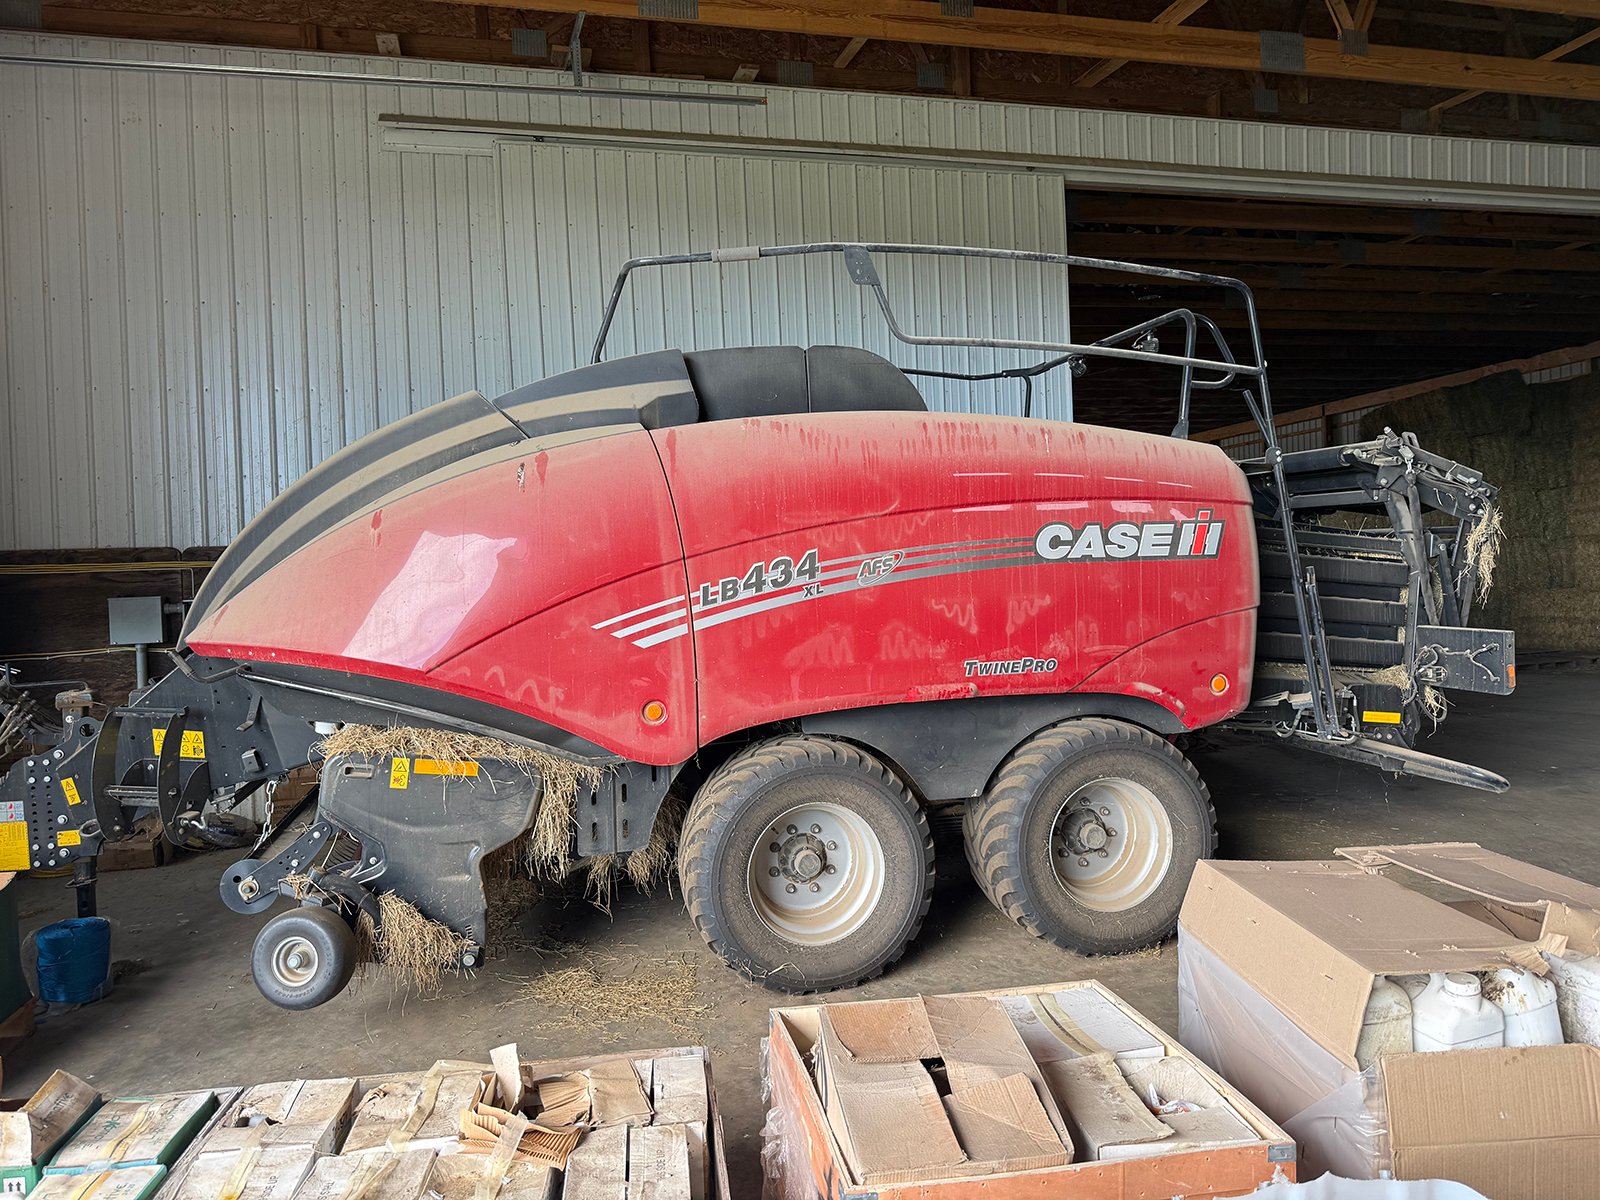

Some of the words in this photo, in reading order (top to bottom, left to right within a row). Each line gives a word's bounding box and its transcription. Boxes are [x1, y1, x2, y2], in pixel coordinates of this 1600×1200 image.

[1035, 523, 1175, 560] CASE
[700, 548, 820, 609] LB434
[857, 555, 895, 579] AFS
[803, 582, 824, 599] XL
